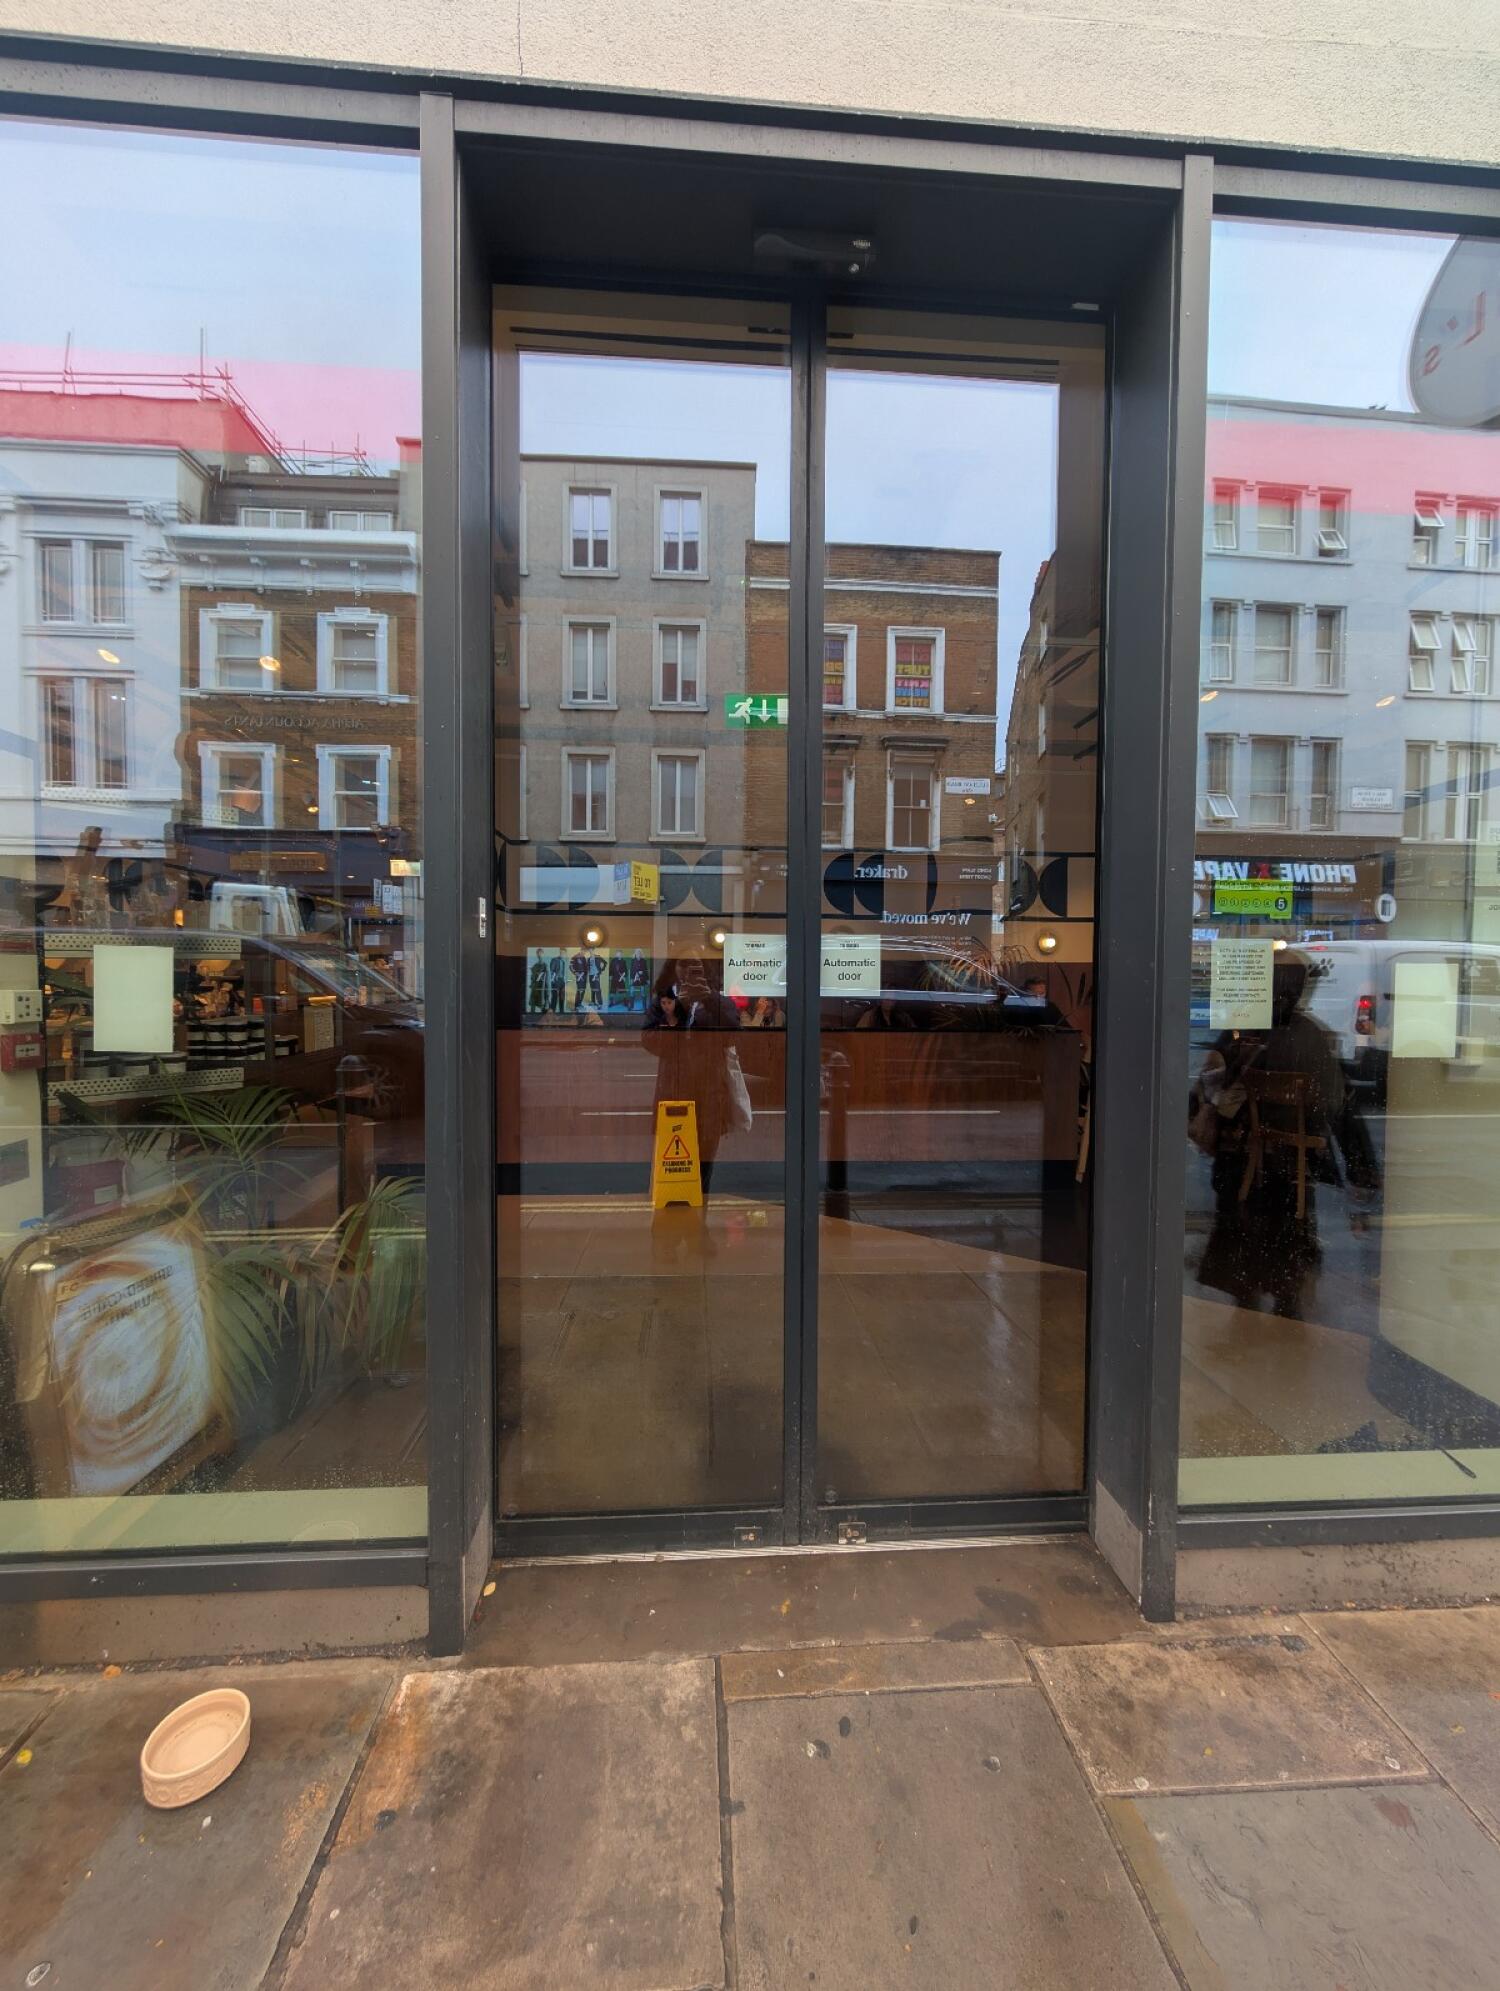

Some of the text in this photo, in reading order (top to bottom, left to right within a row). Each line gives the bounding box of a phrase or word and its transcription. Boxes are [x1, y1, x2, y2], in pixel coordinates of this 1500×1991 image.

[1277, 898, 1286, 910] 5
[728, 957, 782, 967] Automatic
[823, 957, 876, 967] Automatic
[743, 971, 768, 981] door
[837, 971, 862, 981] door
